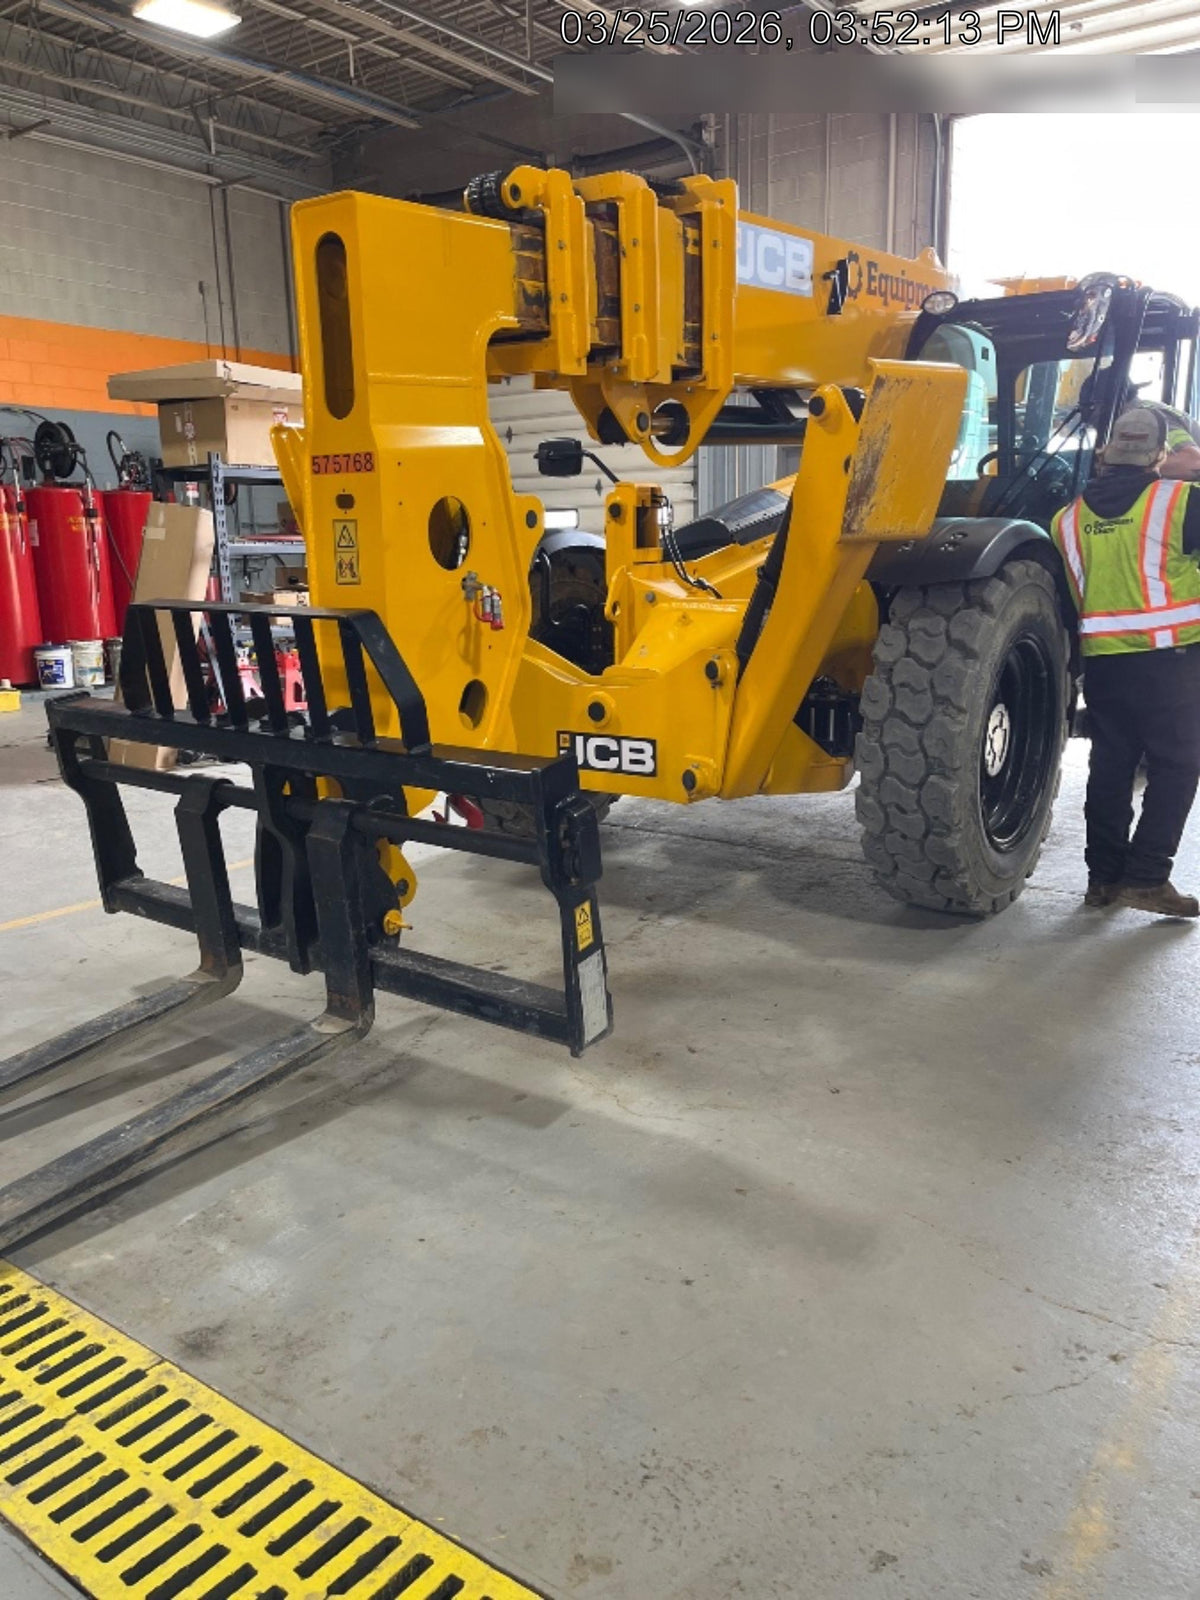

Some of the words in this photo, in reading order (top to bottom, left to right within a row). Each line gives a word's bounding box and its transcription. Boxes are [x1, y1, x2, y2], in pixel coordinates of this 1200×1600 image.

[737, 228, 810, 291] JCB
[866, 260, 937, 309] Equipm
[311, 452, 374, 475] 575768
